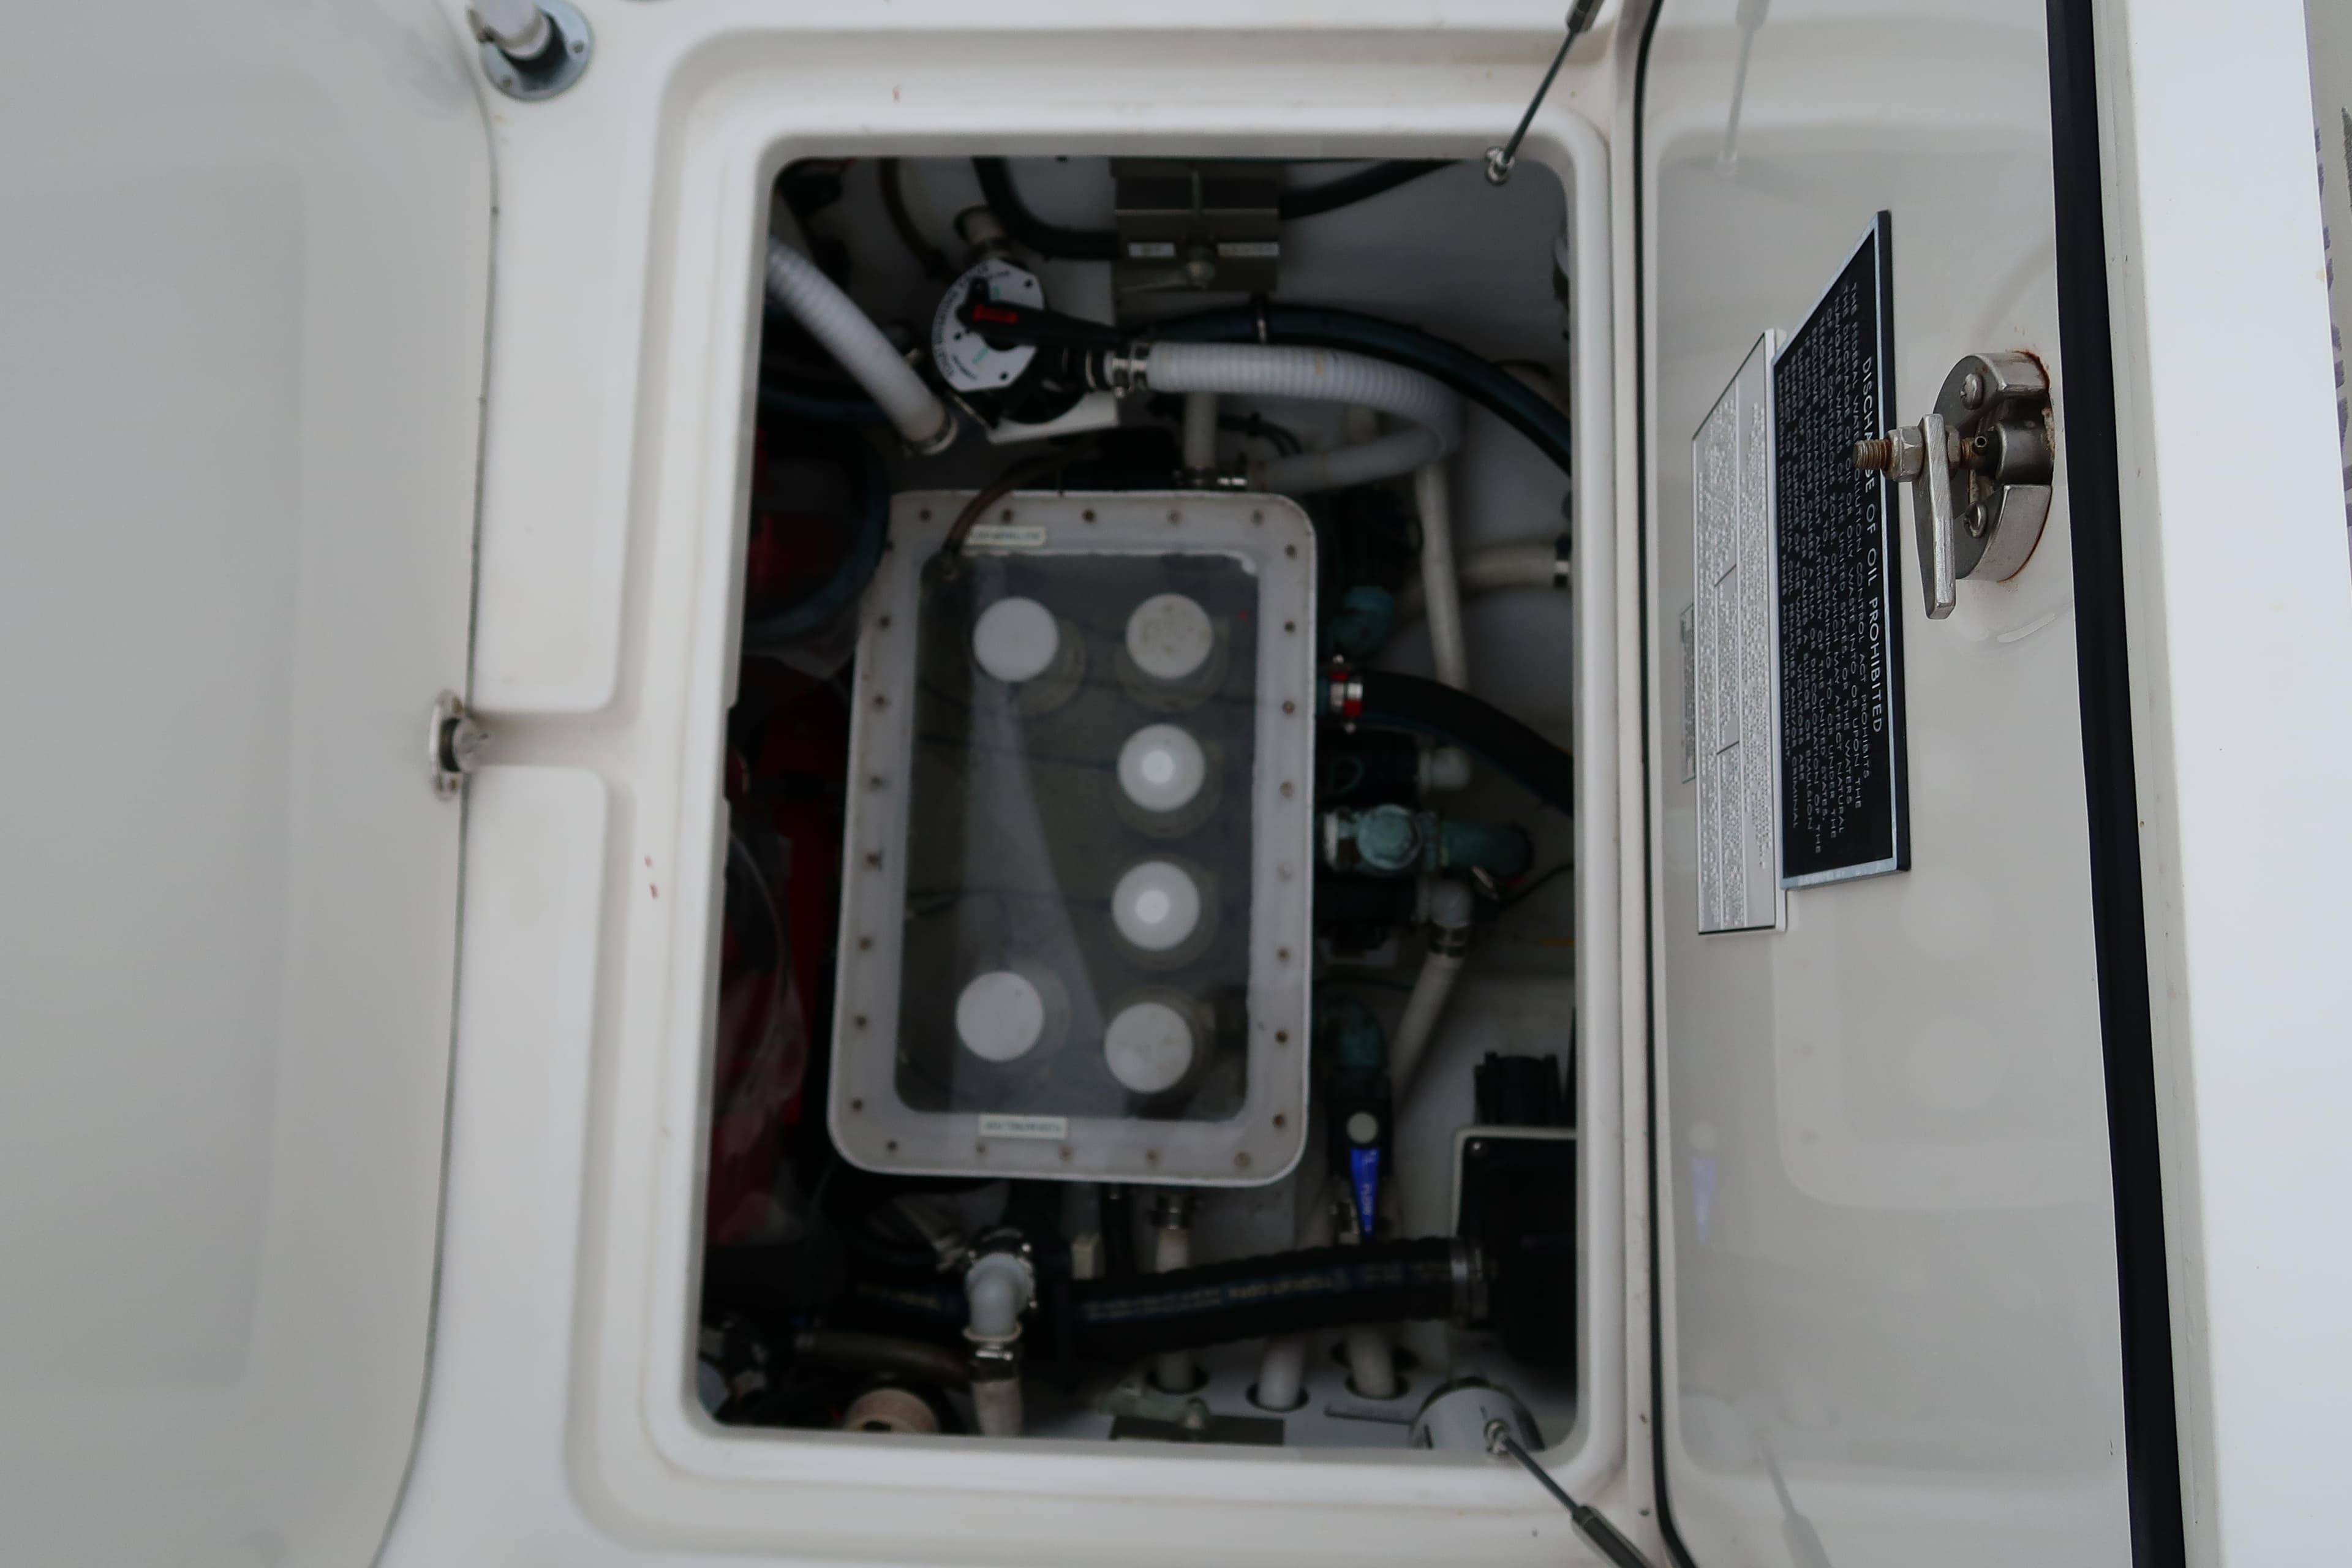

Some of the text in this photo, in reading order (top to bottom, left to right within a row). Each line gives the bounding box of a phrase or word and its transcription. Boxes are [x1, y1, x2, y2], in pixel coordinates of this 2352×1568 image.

[1826, 306, 1832, 331] OF
[1831, 552, 1836, 576] OR
[1844, 424, 1850, 449] OF
[1845, 491, 1852, 516] OR
[1866, 500, 1875, 537] OF
[1837, 461, 1842, 485] OF
[1842, 666, 1848, 690] OR
[1867, 545, 1877, 586] OIL
[1856, 560, 1864, 642] CONTROL
[1860, 694, 1869, 778] PROHIBITS
[1868, 596, 1882, 733] PROHIBITED
[1851, 684, 1858, 707] OR
[1852, 717, 1860, 767] UPON
